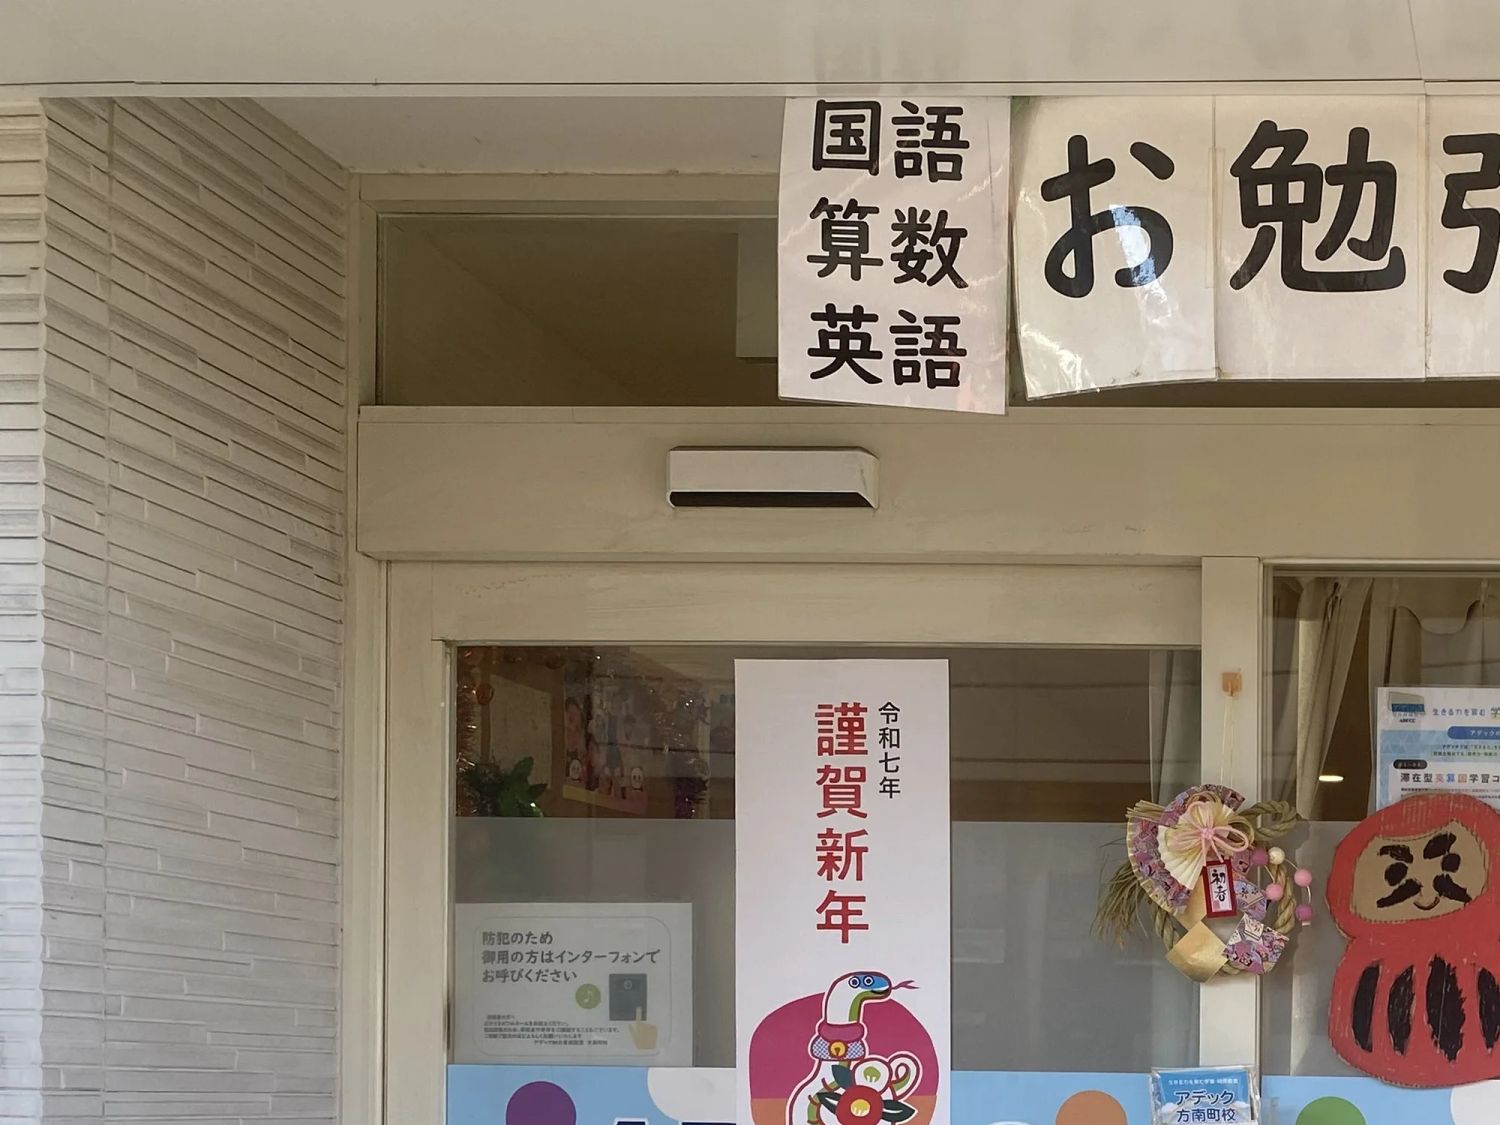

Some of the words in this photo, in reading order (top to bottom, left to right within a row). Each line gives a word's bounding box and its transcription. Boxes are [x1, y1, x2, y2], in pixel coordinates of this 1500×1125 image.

[811, 100, 970, 184] 国語
[806, 197, 969, 290] 算数
[806, 303, 968, 390] 英語
[877, 701, 902, 800] 令和七年
[814, 701, 870, 945] 謹賀新年
[1210, 869, 1227, 901] 初春
[482, 931, 554, 946] 防犯のため
[482, 949, 661, 965] 御用の方はインターフォンで
[482, 968, 578, 984] お呼びください
[1174, 1090, 1235, 1106] アデック
[1176, 1108, 1237, 1123] 方南町校
